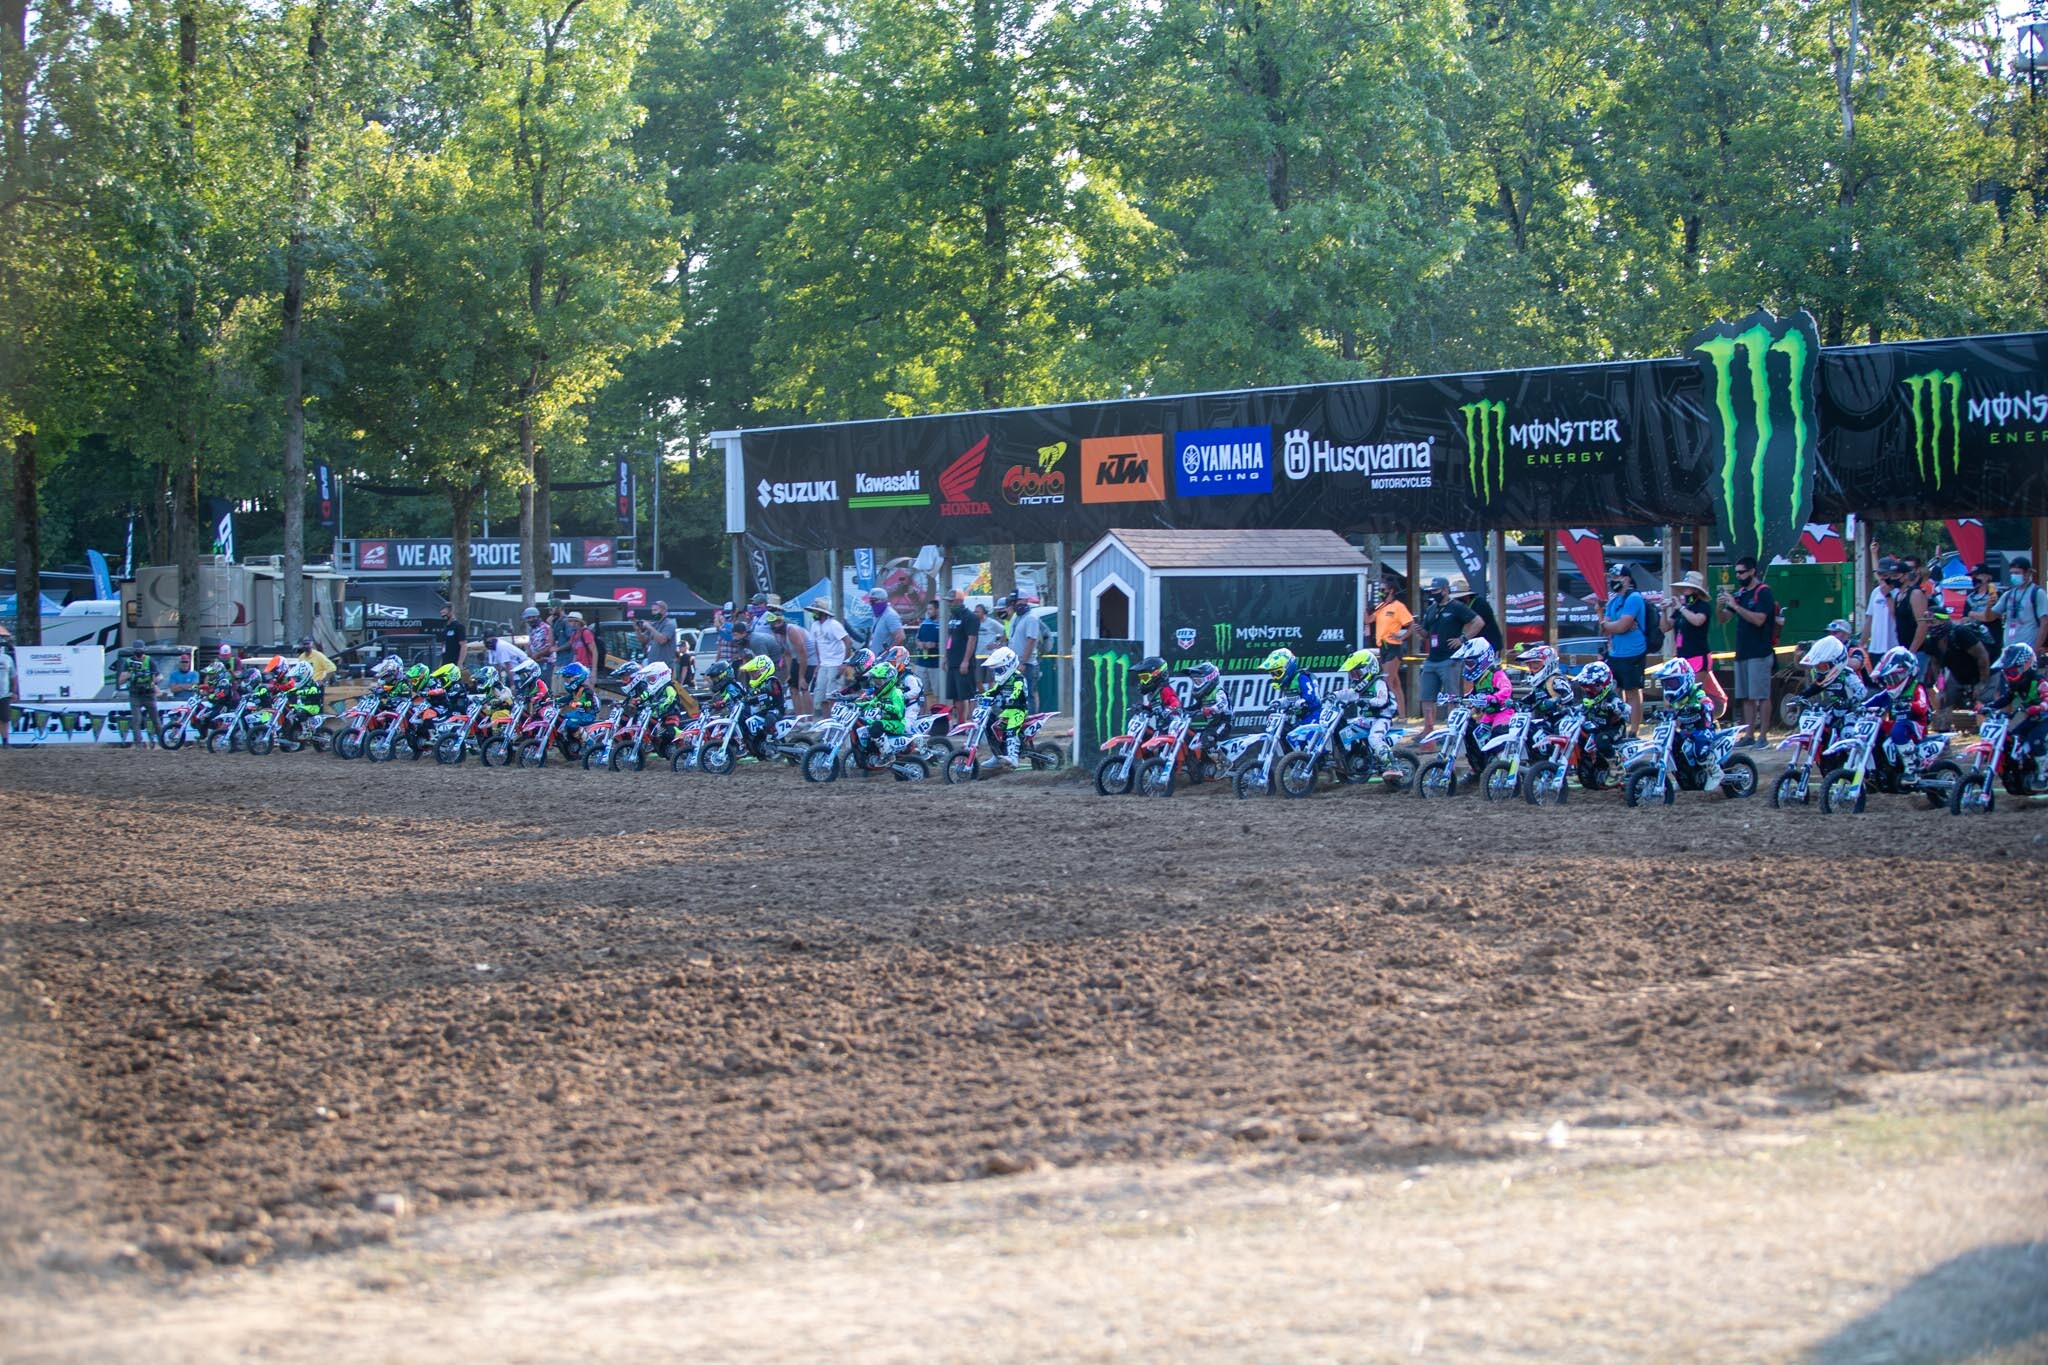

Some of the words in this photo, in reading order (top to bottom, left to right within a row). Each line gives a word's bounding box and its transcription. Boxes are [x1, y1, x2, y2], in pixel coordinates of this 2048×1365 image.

[1509, 417, 1622, 449] MONSTER
[1200, 442, 1264, 472] YAMAHA
[1312, 439, 1432, 476] Husqvarna
[1527, 451, 1604, 465] ENERGY
[1095, 453, 1149, 486] KTM
[855, 470, 920, 493] Kawasaki
[1189, 472, 1261, 483] RACING
[1371, 477, 1433, 489] MOTORCYCLES
[1001, 465, 1065, 505] Cobra
[773, 481, 838, 504] SUZUKI
[1020, 495, 1064, 505] MOTO
[940, 501, 992, 516] HONDA
[396, 544, 426, 567] WE
[428, 544, 453, 567] AR
[469, 542, 572, 565] PROTEON
[1236, 625, 1303, 641] MONSTER
[1317, 628, 1345, 641] AMA
[1322, 711, 1334, 722] 20
[1511, 717, 1524, 729] 25
[779, 723, 792, 732] 74
[1030, 723, 1042, 734] 24
[1802, 719, 1815, 729] 57
[893, 737, 906, 746] 40
[1923, 743, 1938, 758] 30
